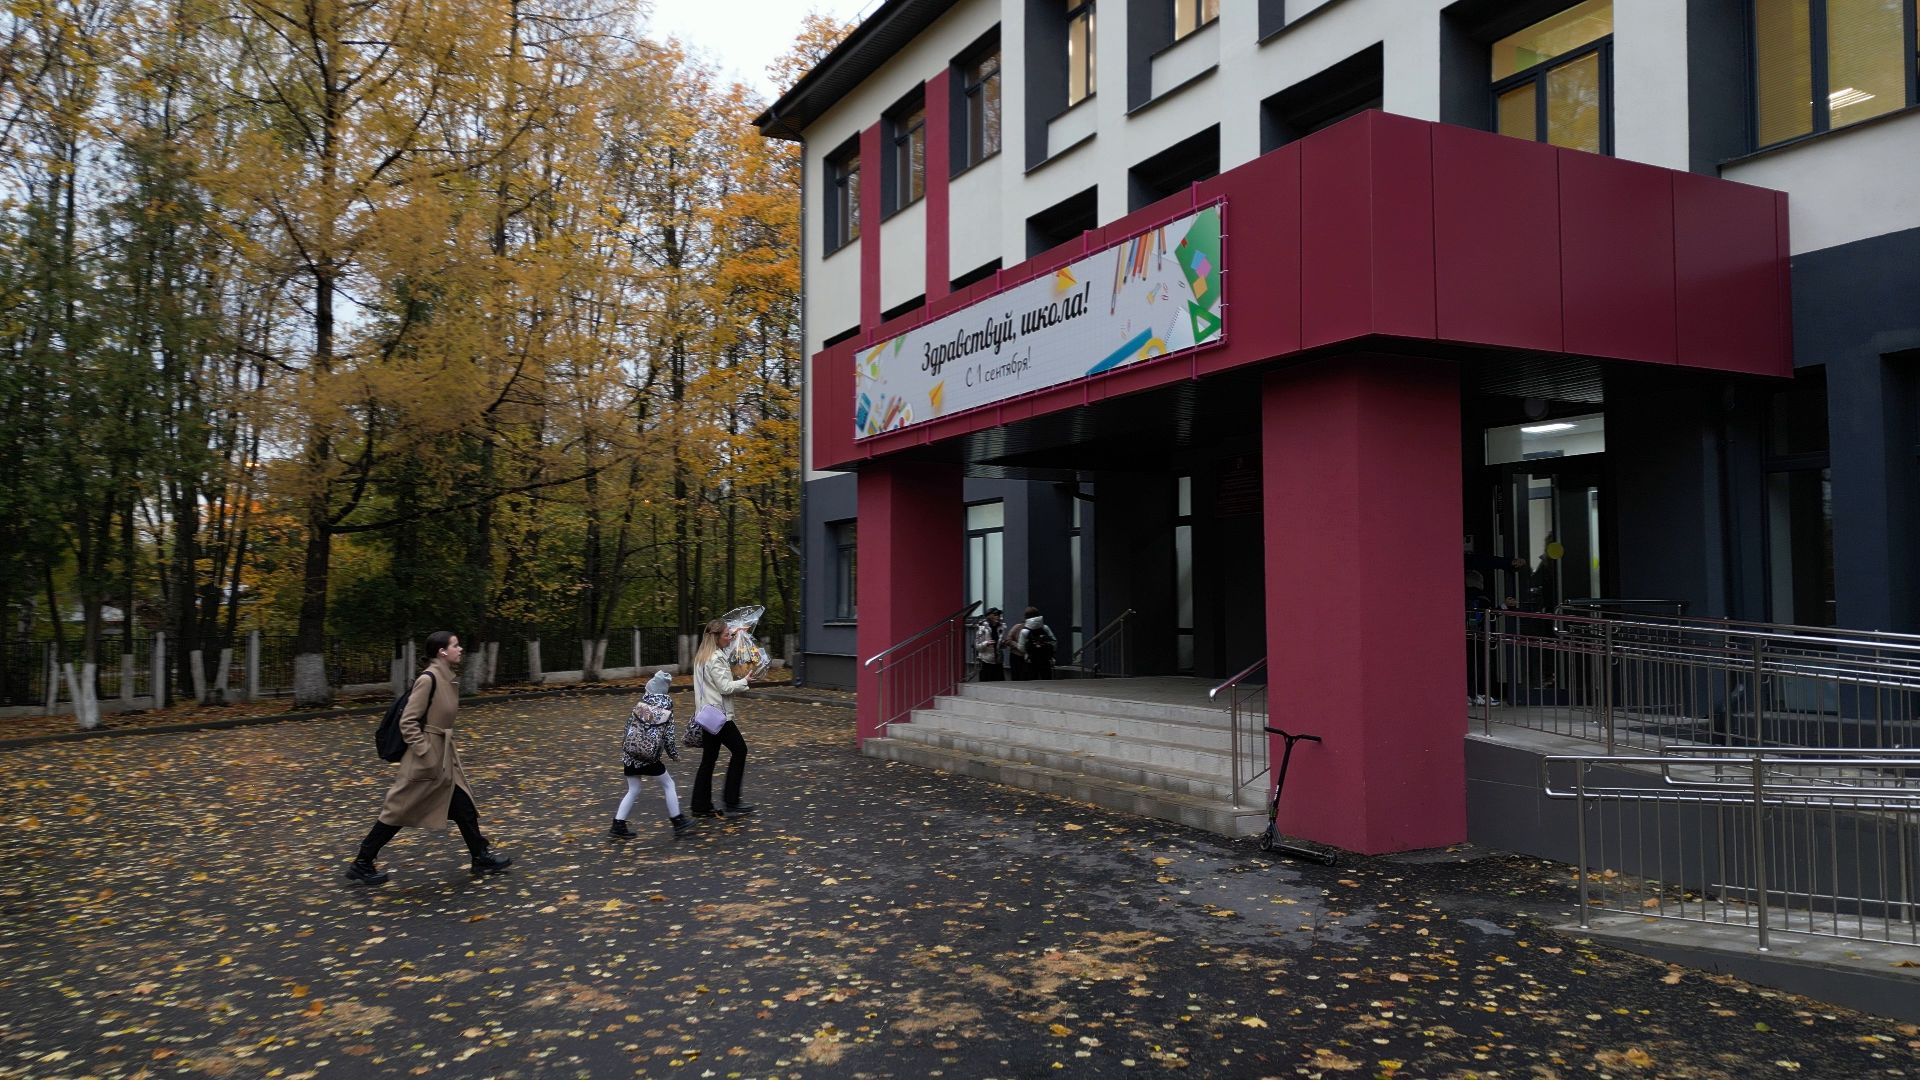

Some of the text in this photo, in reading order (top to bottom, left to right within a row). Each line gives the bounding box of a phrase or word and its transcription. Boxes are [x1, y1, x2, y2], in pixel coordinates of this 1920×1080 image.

[921, 281, 1091, 377] Здравствуй, школа!
[965, 346, 1032, 388] С 1 сентября!
